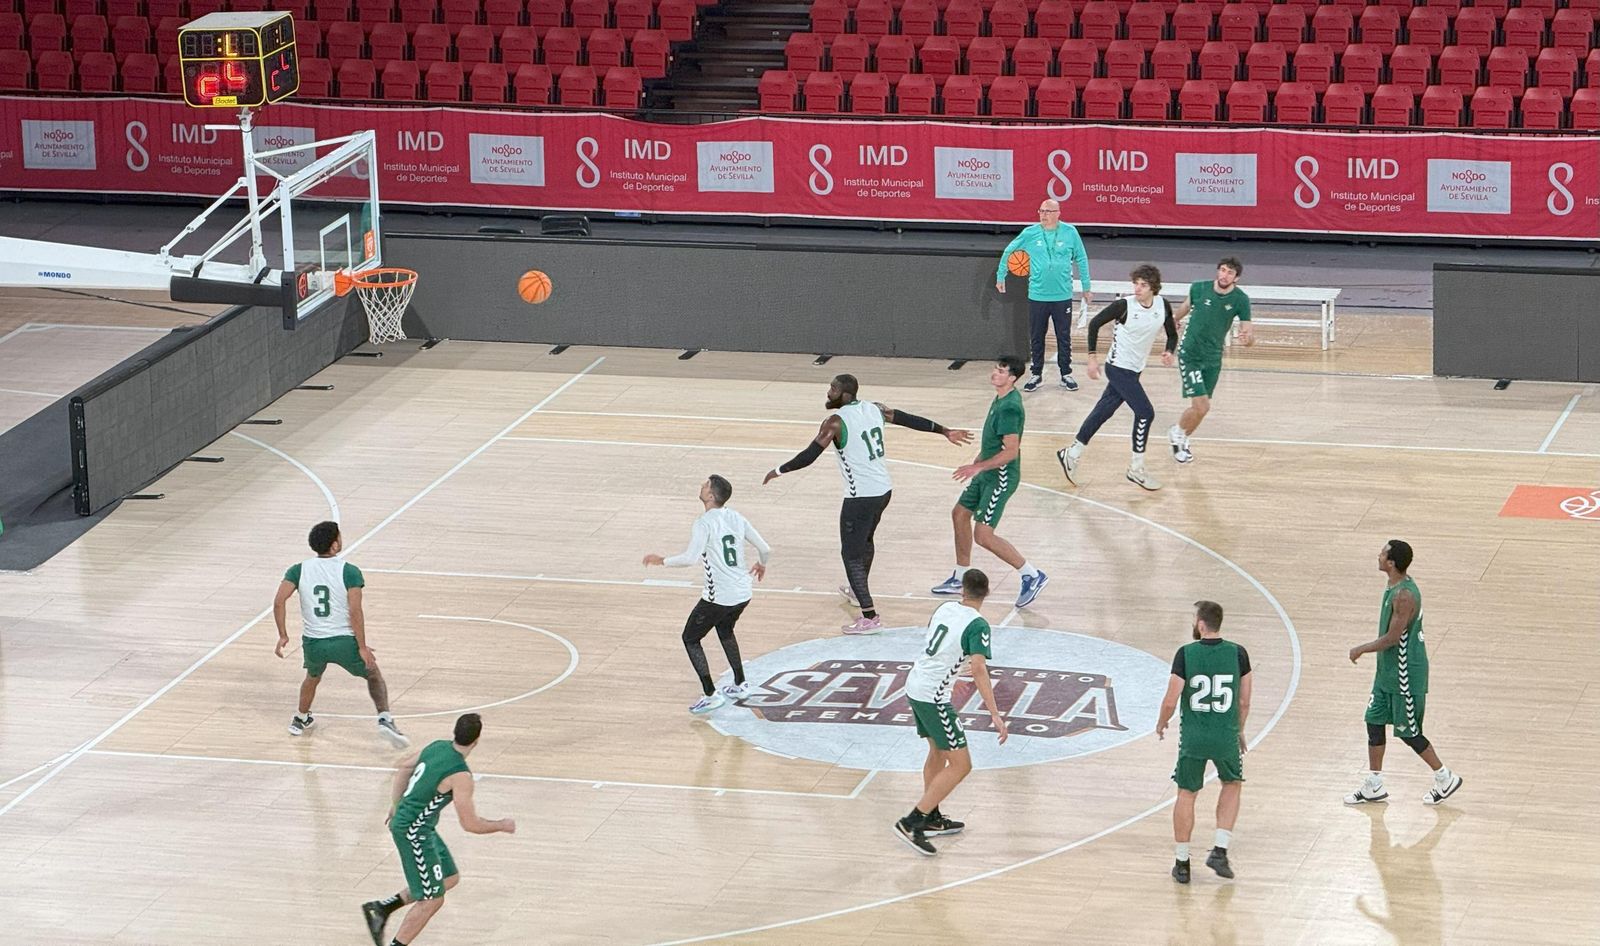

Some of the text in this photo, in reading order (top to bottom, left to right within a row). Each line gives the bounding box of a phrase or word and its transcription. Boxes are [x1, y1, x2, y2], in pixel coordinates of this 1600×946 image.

[172, 123, 218, 144] IMD
[397, 130, 444, 151] IMD
[624, 138, 672, 161] IMD
[859, 144, 909, 166] IMD
[158, 154, 233, 167] Instituto Municipal
[1098, 149, 1149, 172] IMD
[171, 165, 221, 176] de Deportes
[383, 162, 460, 173] Instituto Municipal
[1347, 157, 1400, 180] IMD
[409, 174, 448, 183] Deportes
[609, 170, 688, 182] Instituto Municipal
[843, 177, 924, 188] Instituto Municipal
[622, 182, 675, 193] de Deportes
[856, 189, 911, 199] de Deportes
[1082, 182, 1165, 195] Instituto Municipal
[1095, 194, 1151, 205] de Deportes
[1330, 190, 1416, 203] Instituto Municipal
[1344, 202, 1402, 213] de Deportes
[43, 271, 71, 279] MONDO
[1188, 370, 1203, 384] 12
[861, 426, 884, 460] 13
[721, 534, 738, 567] 6
[313, 584, 331, 618] 3
[925, 623, 949, 657] 0
[1189, 673, 1234, 713] 25
[432, 864, 443, 881] 8
